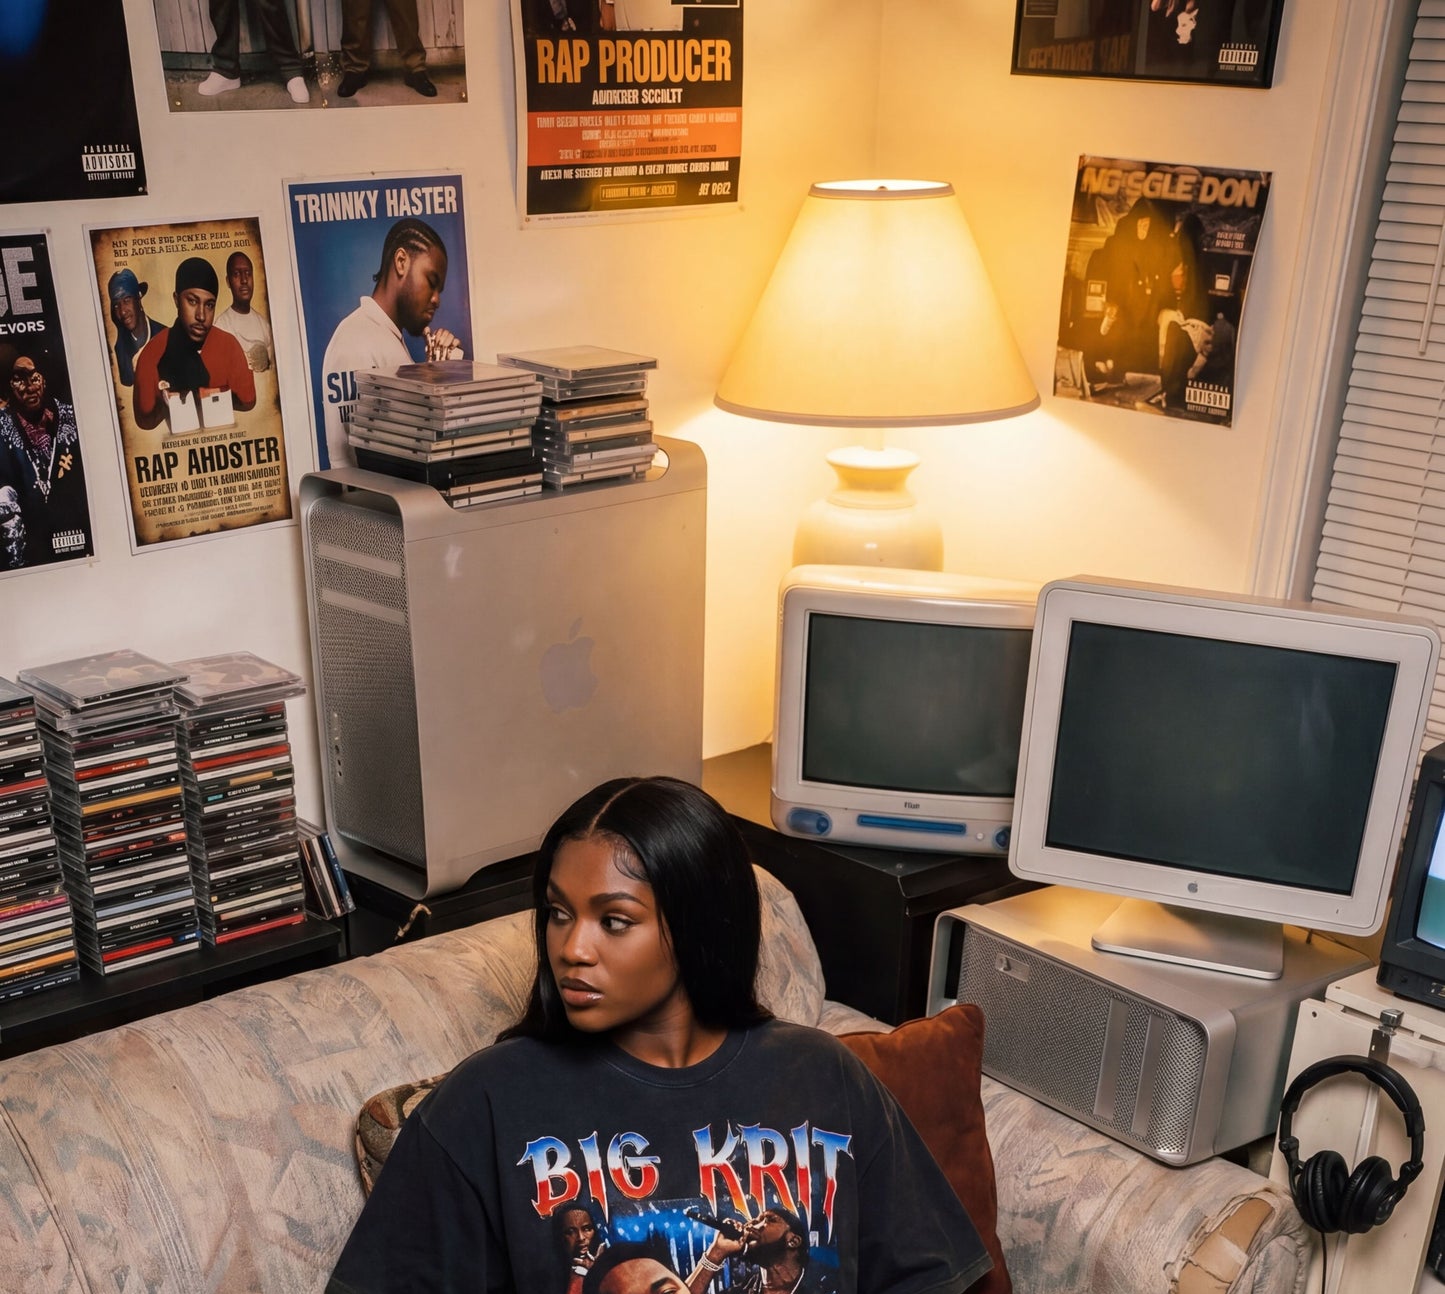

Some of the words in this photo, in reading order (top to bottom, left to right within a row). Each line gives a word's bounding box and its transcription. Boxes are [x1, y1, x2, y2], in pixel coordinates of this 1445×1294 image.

[536, 39, 590, 84] RAP
[599, 38, 732, 84] PRODUCER
[294, 189, 379, 223] TRINNKY
[385, 185, 458, 218] HASTER
[1198, 175, 1261, 209] DON
[0, 246, 44, 317] E
[134, 451, 179, 484] RAP
[188, 436, 281, 477] AHDSTER
[516, 1130, 661, 1223] BIG
[693, 1120, 854, 1242] KRIT
